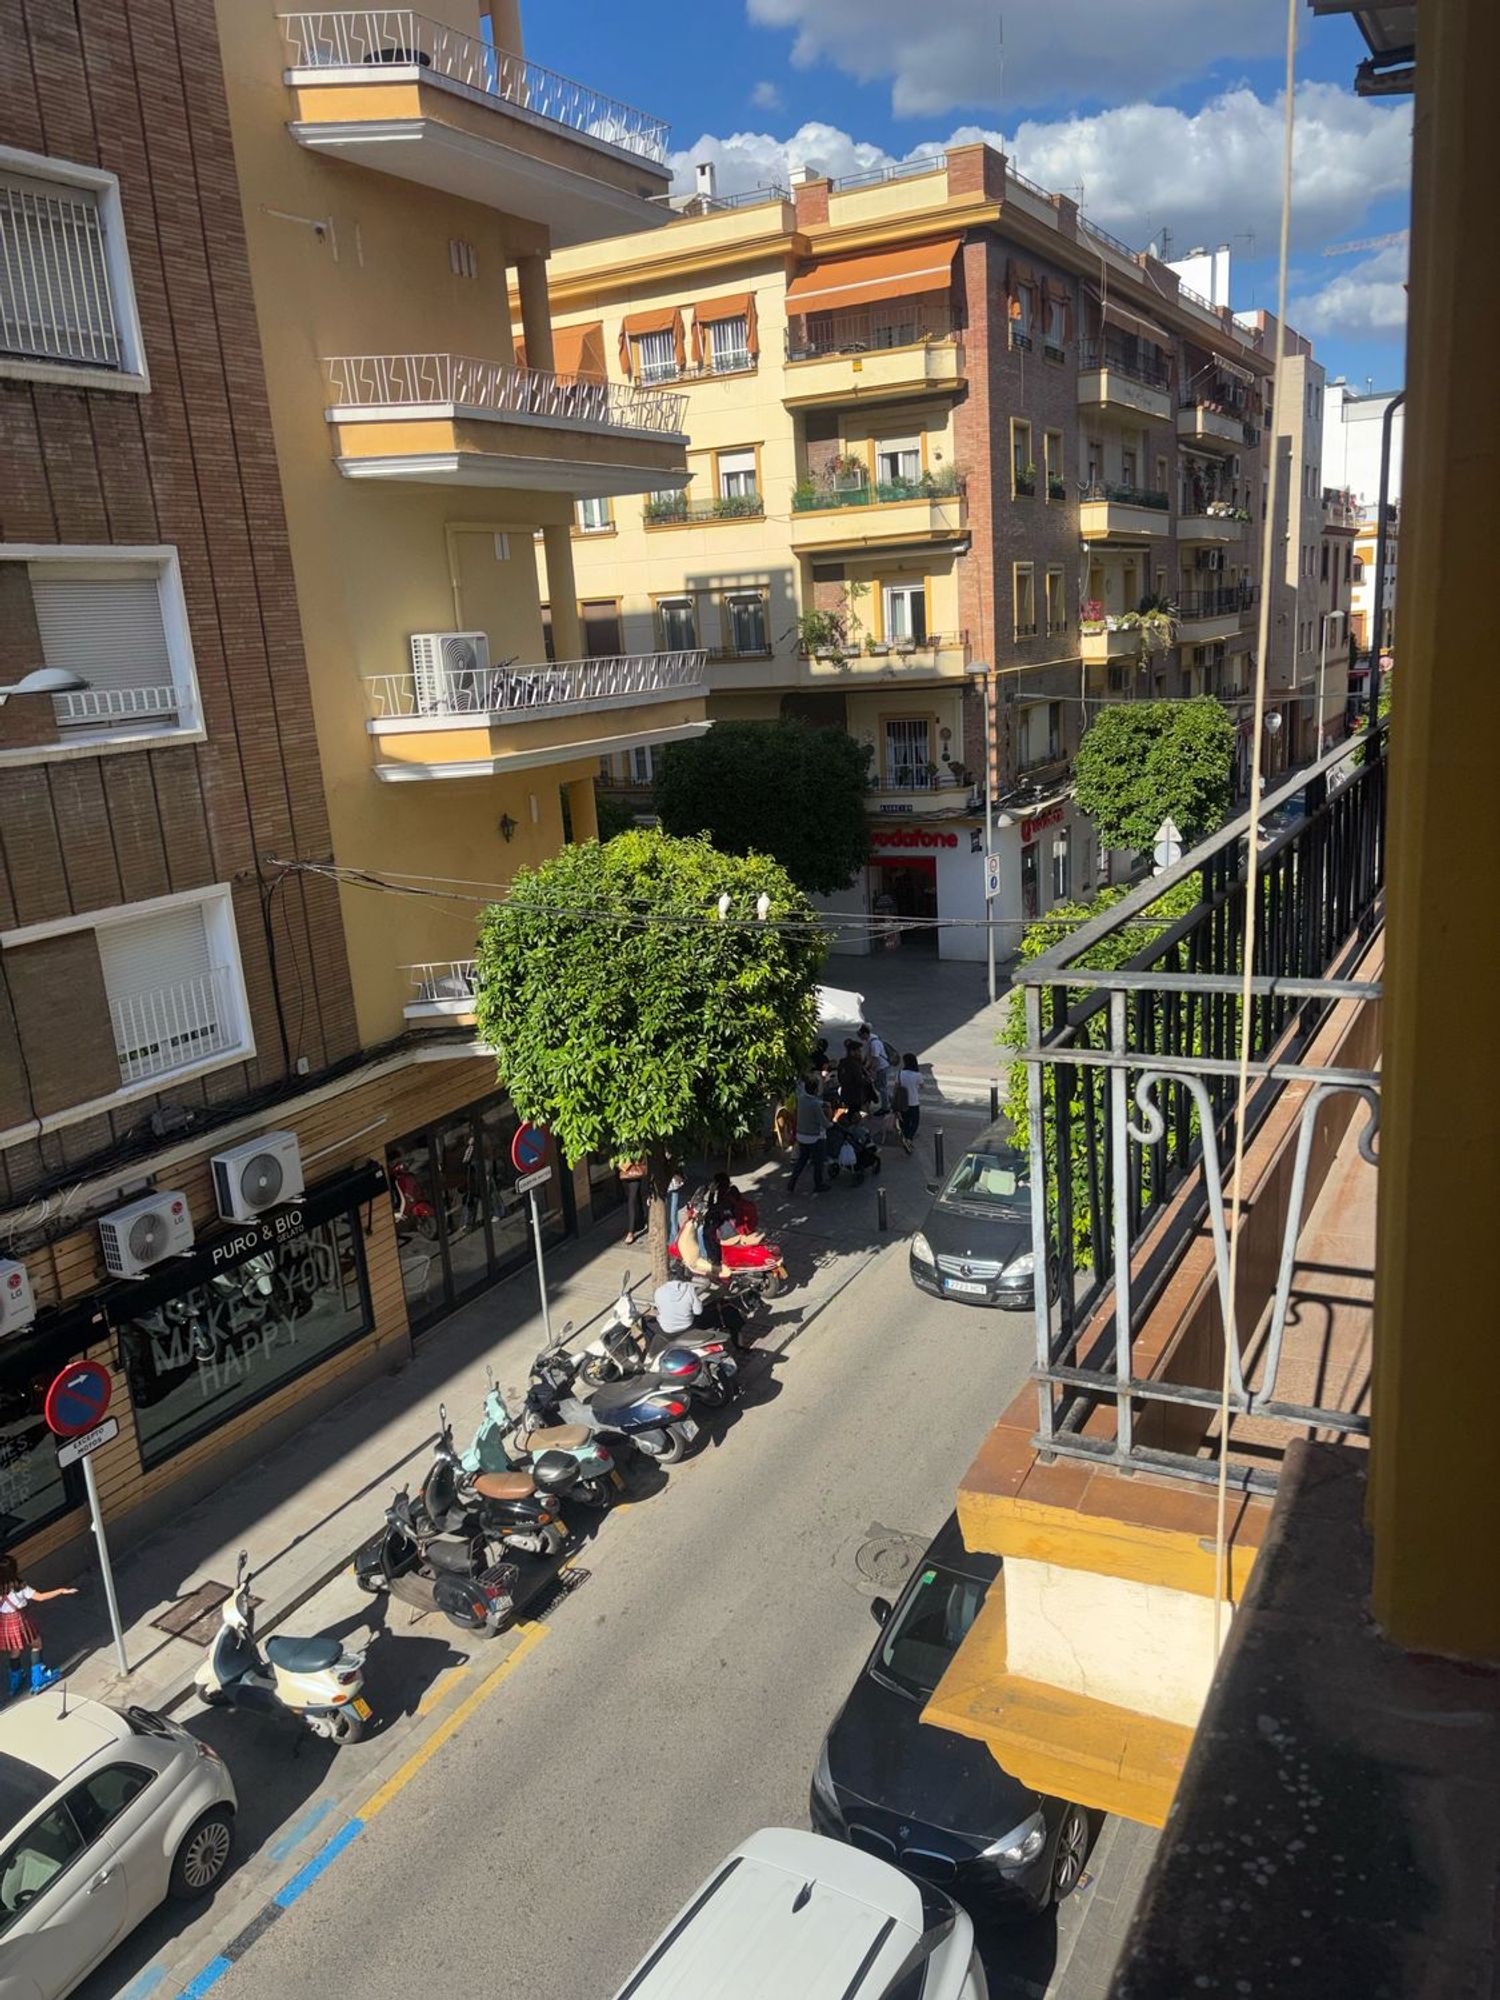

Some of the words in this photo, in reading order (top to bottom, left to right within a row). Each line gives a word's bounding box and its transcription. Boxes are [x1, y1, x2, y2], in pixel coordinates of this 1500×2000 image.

[174, 1215, 184, 1225] LG
[212, 1231, 257, 1265] PURO
[262, 1225, 273, 1240] &
[275, 1210, 302, 1234] BIO
[276, 1223, 304, 1243] GELATO
[11, 1288, 22, 1299] LG
[151, 1291, 268, 1377] MAKES
[199, 1307, 298, 1396] HAPPY
[73, 1427, 104, 1449] EXCEPTO
[77, 1437, 102, 1454] MOTOS
